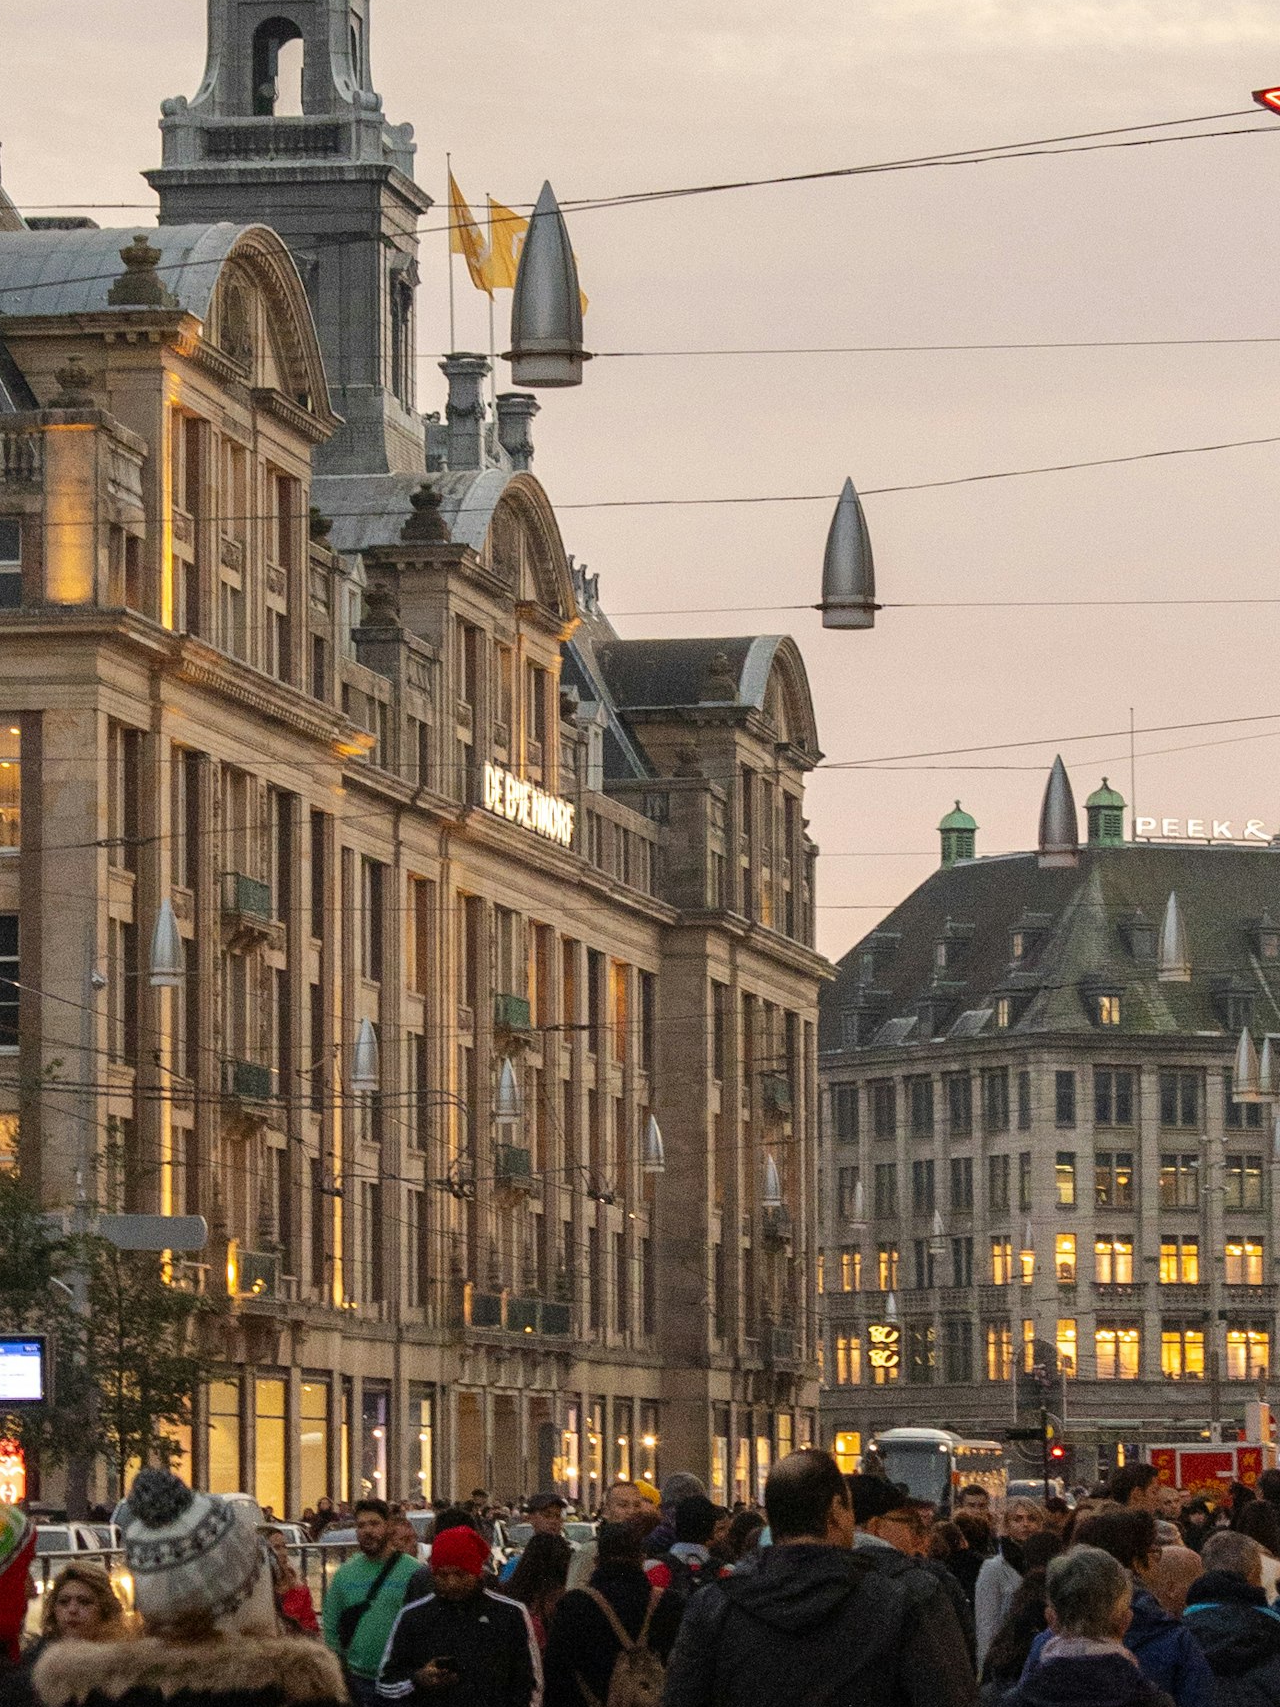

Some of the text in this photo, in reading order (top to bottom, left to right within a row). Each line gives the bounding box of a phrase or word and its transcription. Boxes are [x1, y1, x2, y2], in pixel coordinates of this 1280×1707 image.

[485, 761, 504, 817] DE
[1135, 816, 1232, 840] PEEK
[1244, 818, 1273, 842] &
